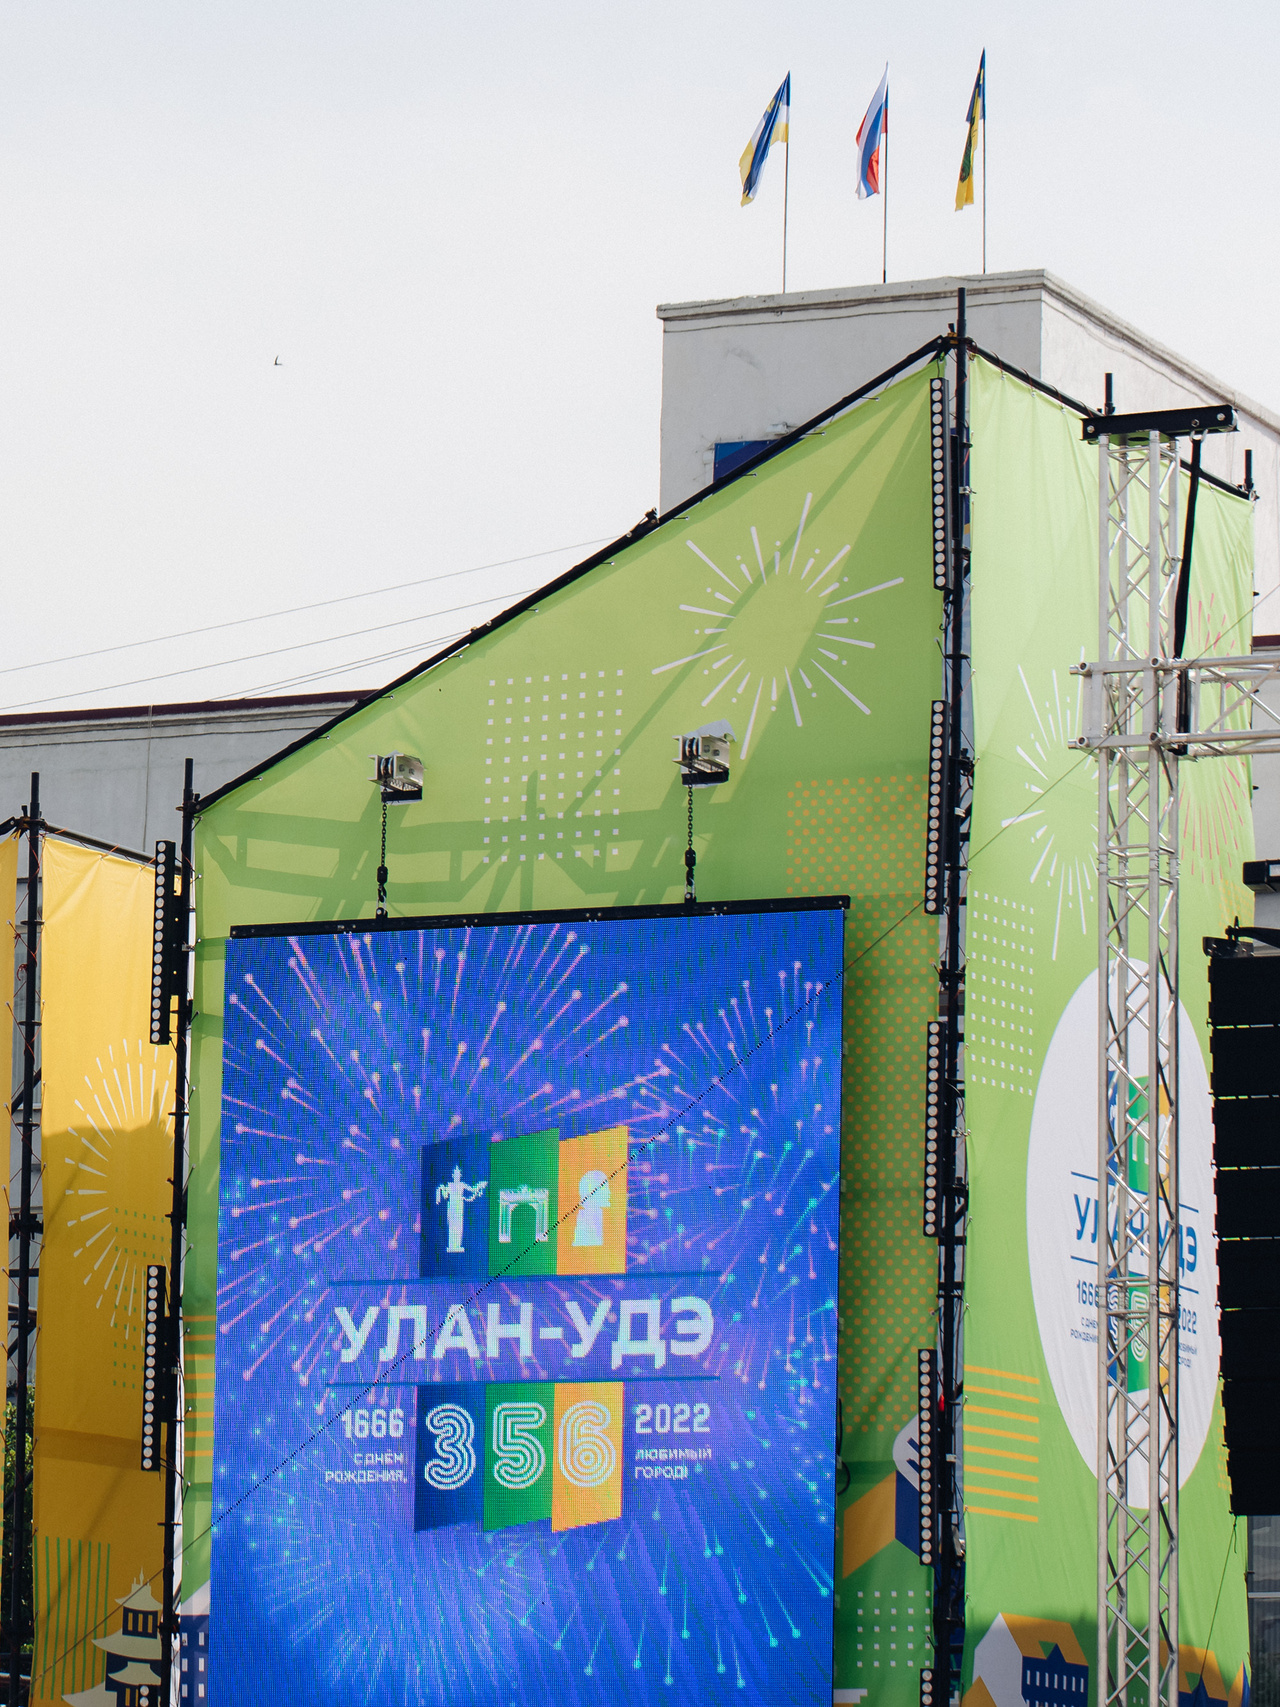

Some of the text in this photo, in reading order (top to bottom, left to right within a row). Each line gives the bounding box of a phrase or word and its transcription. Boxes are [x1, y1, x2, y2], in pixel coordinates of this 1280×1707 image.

[333, 1296, 714, 1370] УЛАН-УДЭ
[1177, 1304, 1197, 1334] 022
[341, 1408, 404, 1438] 1666
[635, 1403, 710, 1434] 2022
[354, 1453, 363, 1465] С
[424, 1401, 617, 1490] 356
[635, 1445, 712, 1461] ЛЮБИМЫЙ
[635, 1466, 688, 1480] ГОРОД!
